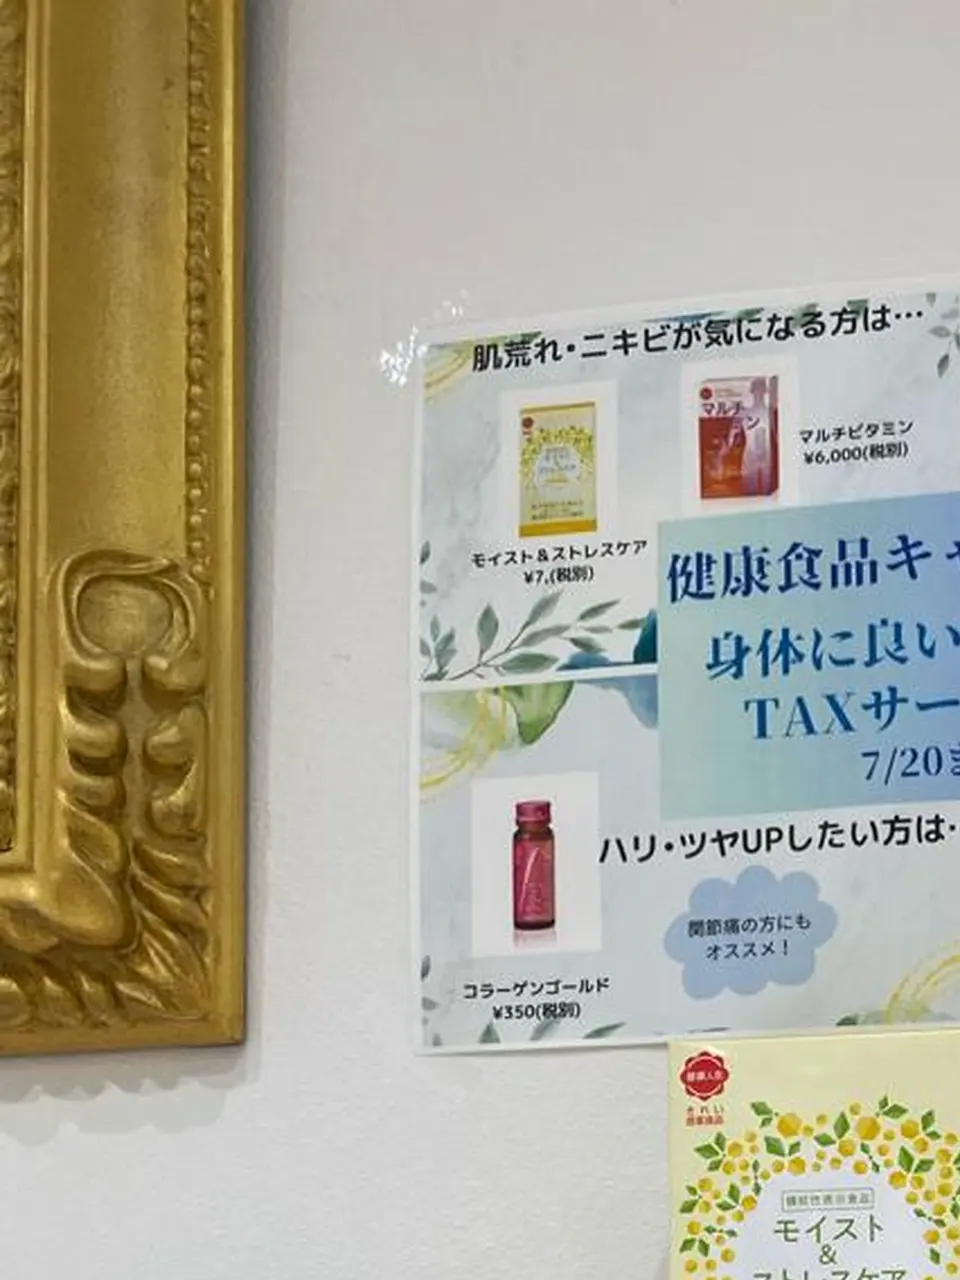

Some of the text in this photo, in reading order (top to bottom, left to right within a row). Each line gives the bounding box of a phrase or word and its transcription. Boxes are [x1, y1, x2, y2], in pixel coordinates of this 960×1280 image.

[472, 306, 925, 372] 肌荒れ・ニキビが気になる方は…
[799, 421, 915, 444] マルチビタミン
[803, 442, 909, 466] ¥6,000(税別)
[523, 566, 594, 586] ¥7,(税別)
[688, 914, 812, 938] 関節痛の方にも
[706, 939, 788, 960] オススメ！
[463, 977, 610, 999] コラーゲンゴールド
[492, 1003, 581, 1020] ¥350(税別)
[774, 1214, 885, 1243] モイスト
[819, 1244, 838, 1265] &
